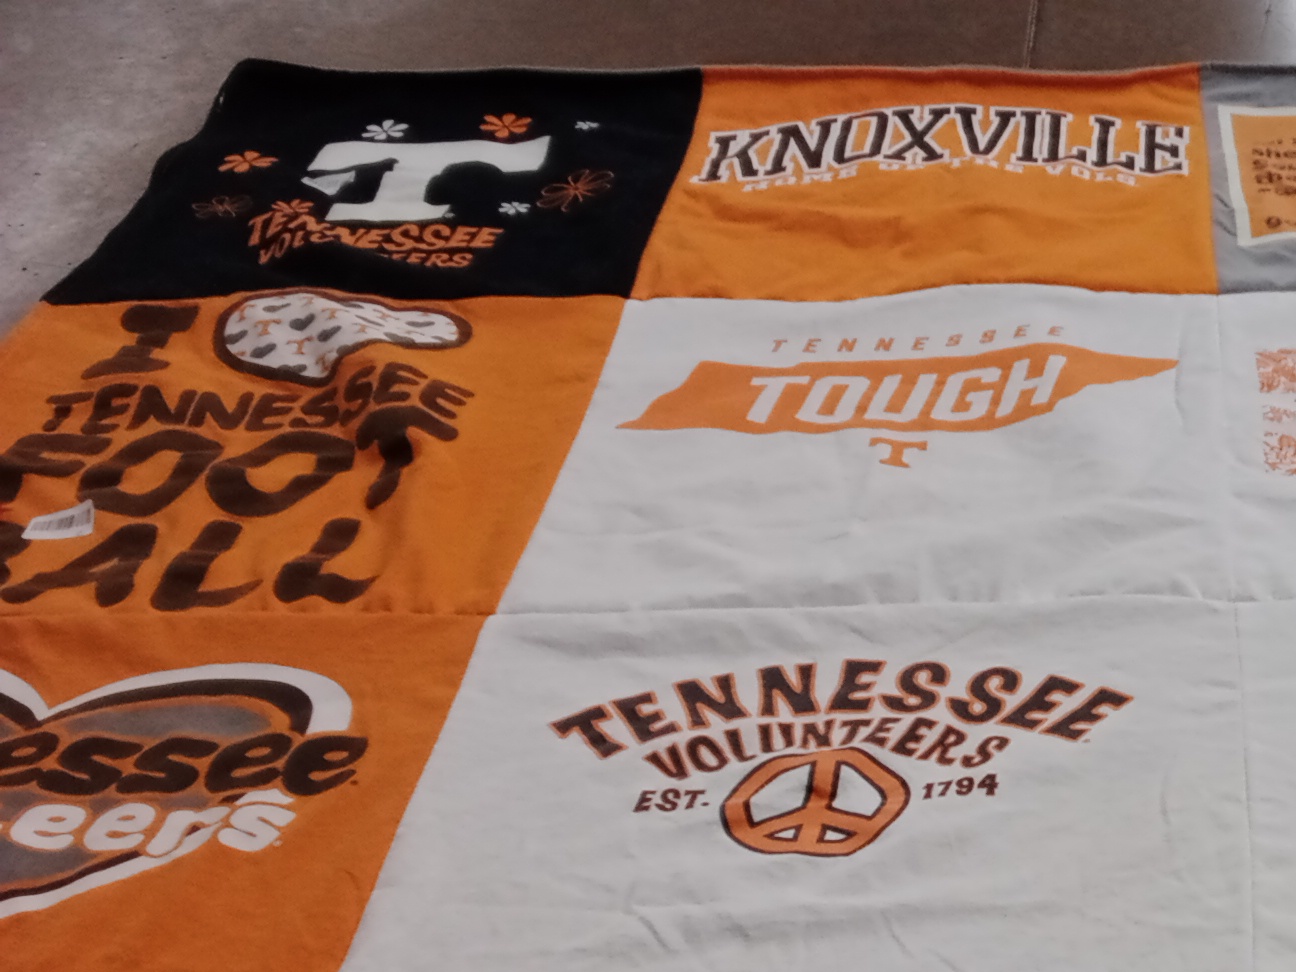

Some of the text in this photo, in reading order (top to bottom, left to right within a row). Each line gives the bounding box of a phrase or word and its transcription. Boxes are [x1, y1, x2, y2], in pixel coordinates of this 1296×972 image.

[690, 103, 1190, 184] KNOXVILLE
[81, 304, 199, 379] I
[771, 324, 1066, 354] TENNESSEE
[42, 362, 475, 434] TENNESSEE
[745, 354, 1067, 425] TOUGH
[0, 422, 459, 518] FOOT
[868, 436, 928, 468] T
[549, 658, 1135, 760] TENNESSEE
[643, 716, 1010, 780] VOLUNTEERS
[633, 772, 1000, 813] EST. 1794
